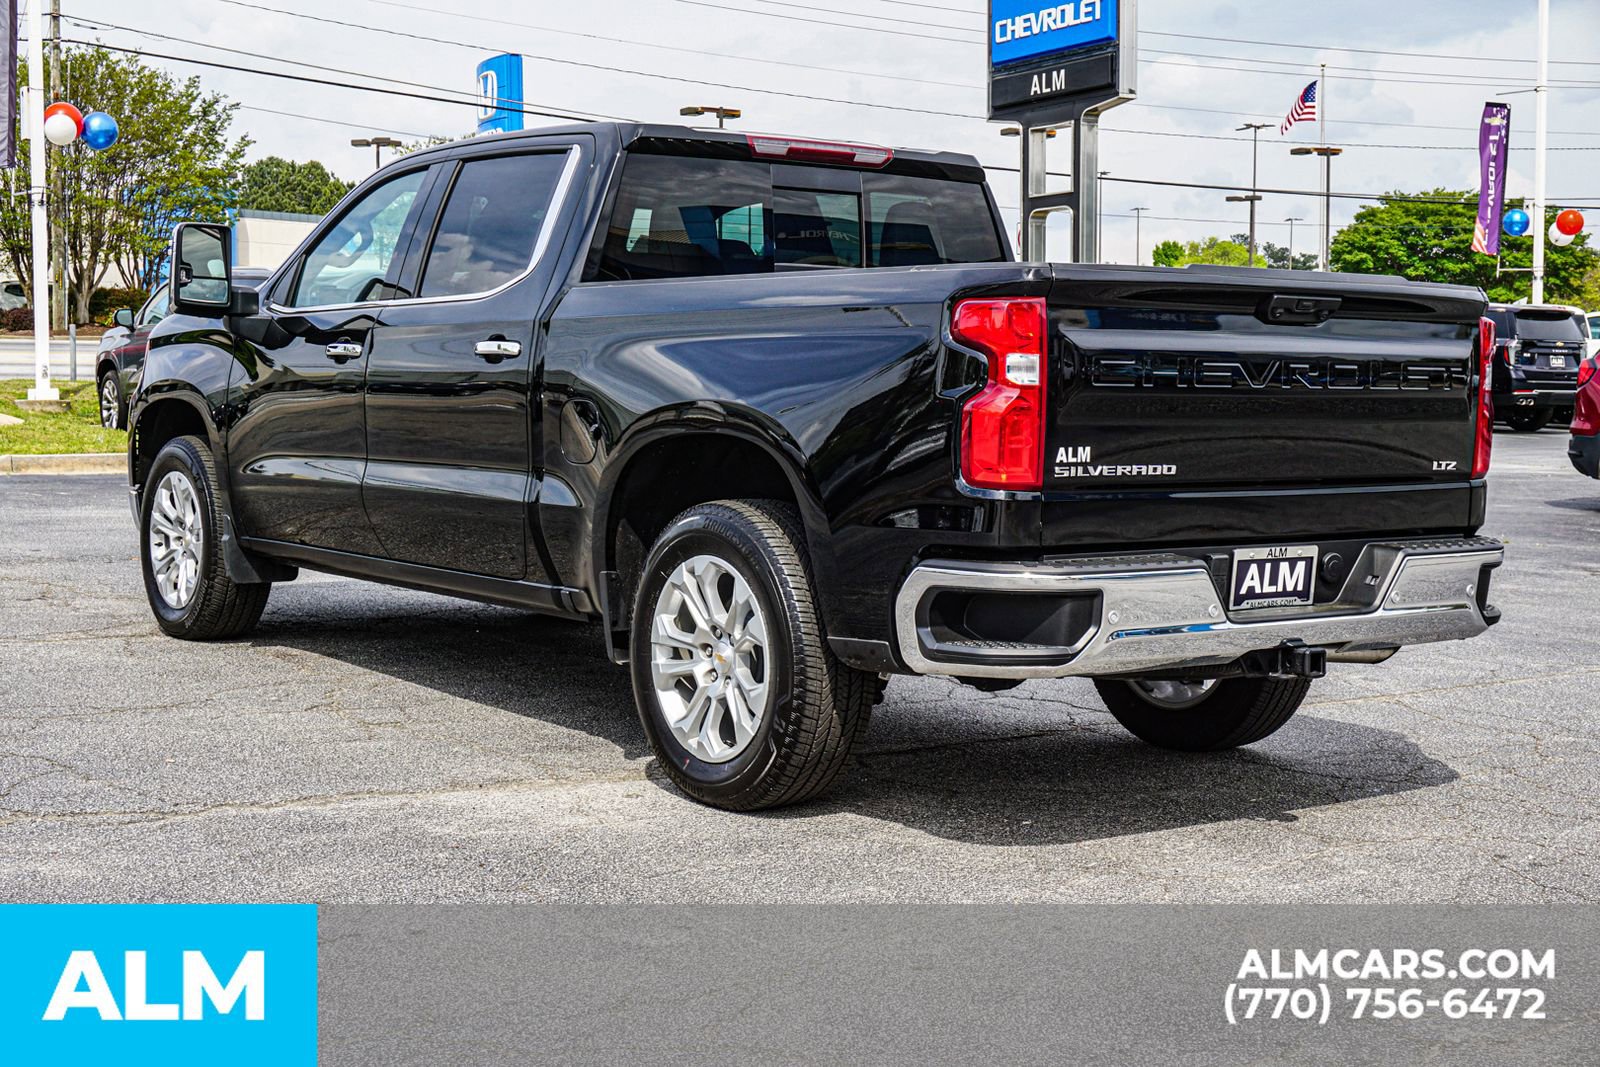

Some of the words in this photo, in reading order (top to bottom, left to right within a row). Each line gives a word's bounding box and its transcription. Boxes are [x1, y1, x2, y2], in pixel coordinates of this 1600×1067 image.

[995, 0, 1101, 43] CHEVROLET
[1030, 69, 1066, 95] ALM
[1091, 357, 1467, 391] CHEVROLET
[1055, 446, 1091, 463] ALM
[1054, 464, 1177, 478] SILVERADO
[1432, 460, 1457, 471] LTZ
[1266, 547, 1288, 559] ALM
[1239, 560, 1306, 595] ALM
